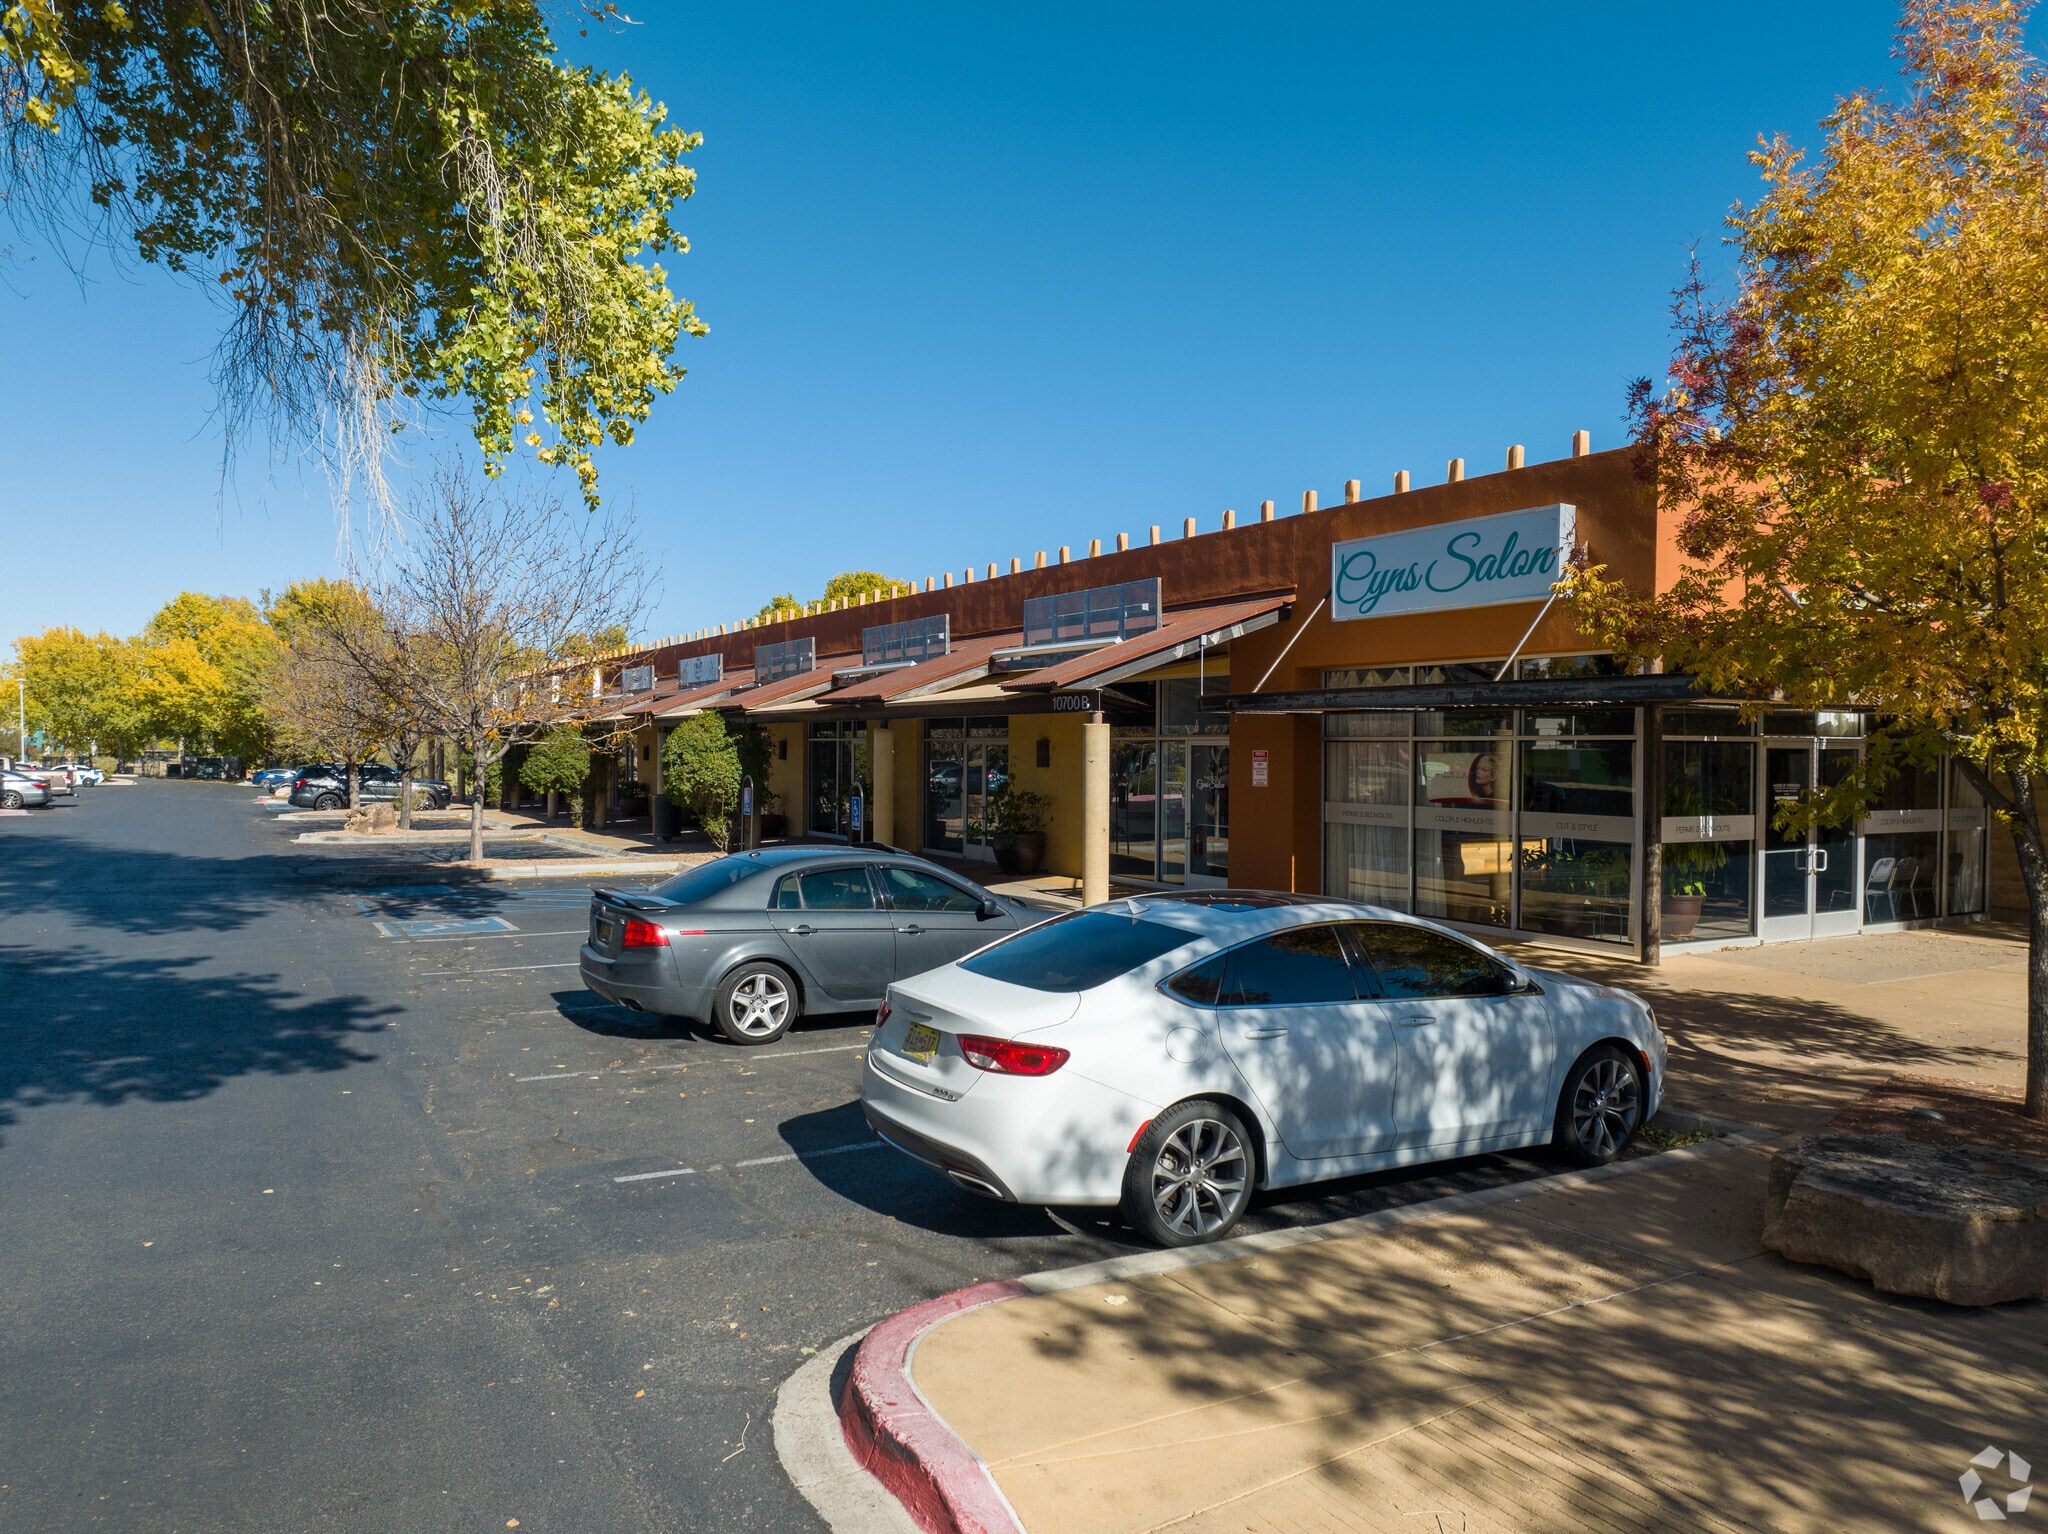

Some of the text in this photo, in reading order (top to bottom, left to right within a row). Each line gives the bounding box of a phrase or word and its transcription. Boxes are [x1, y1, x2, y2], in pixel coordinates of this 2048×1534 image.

[1336, 531, 1556, 615] Cyns Salon
[1052, 695, 1091, 710] 10700 B
[1342, 809, 1359, 818] PERMS
[1364, 811, 1393, 820] BLOWOUTS
[1434, 815, 1455, 823] COLOR
[1460, 817, 1495, 826] HIGHLIGHTS
[1556, 822, 1570, 830] CUT
[1577, 823, 1599, 832] STYLE
[1675, 825, 1695, 834] PERMS
